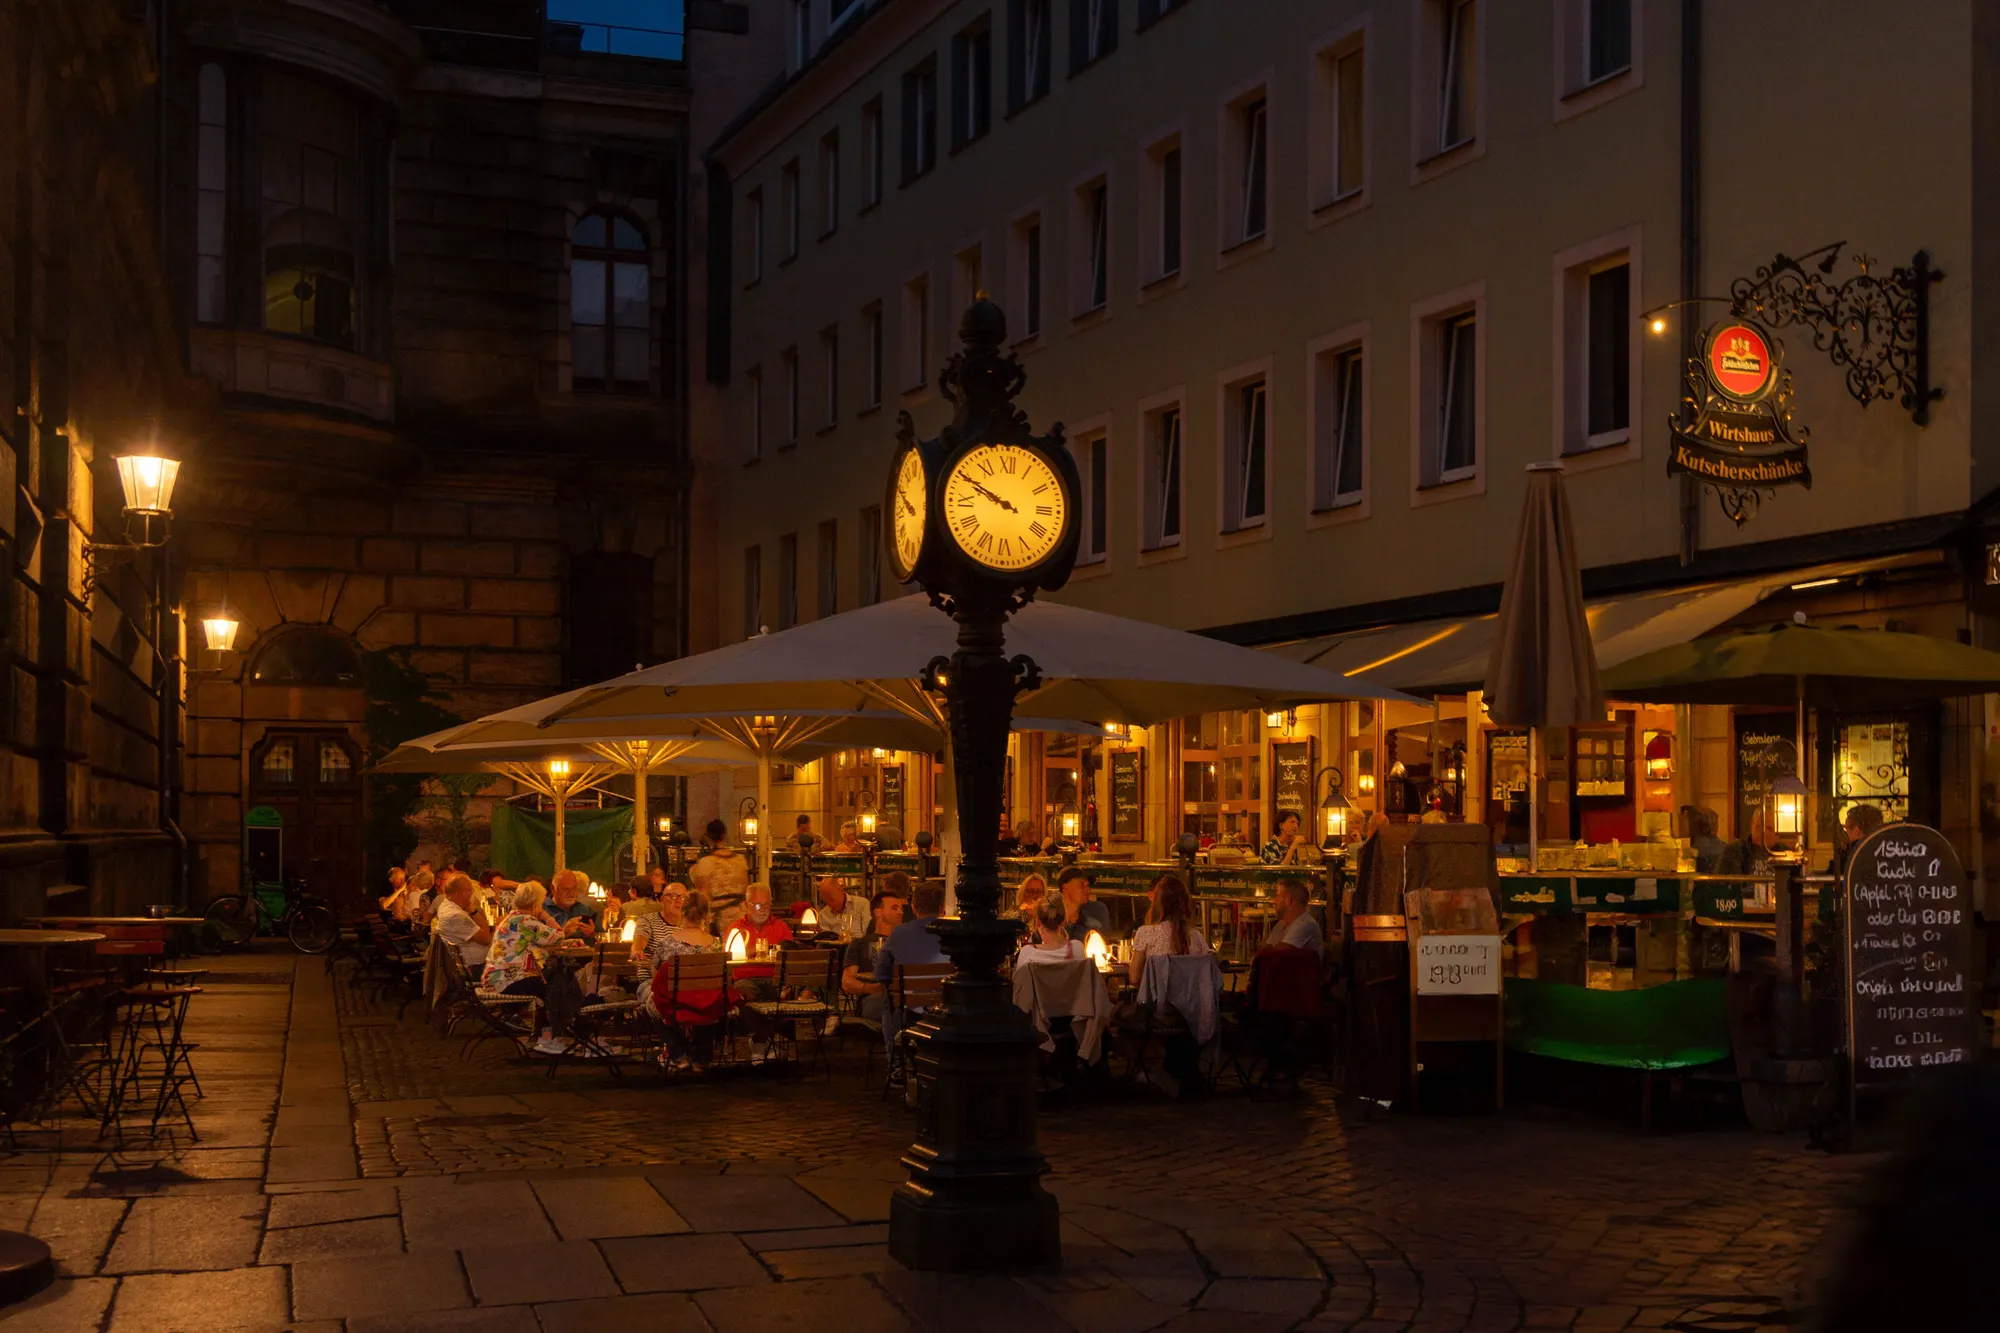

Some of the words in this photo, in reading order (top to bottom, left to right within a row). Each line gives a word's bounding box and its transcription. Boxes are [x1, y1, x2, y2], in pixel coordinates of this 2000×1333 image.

[1708, 419, 1775, 444] Wirtshaus
[1000, 455, 1017, 475] XII
[1676, 446, 1803, 481] Kutscherschänke
[1032, 483, 1049, 496] II
[1035, 505, 1053, 516] III
[1867, 911, 1895, 926] oder
